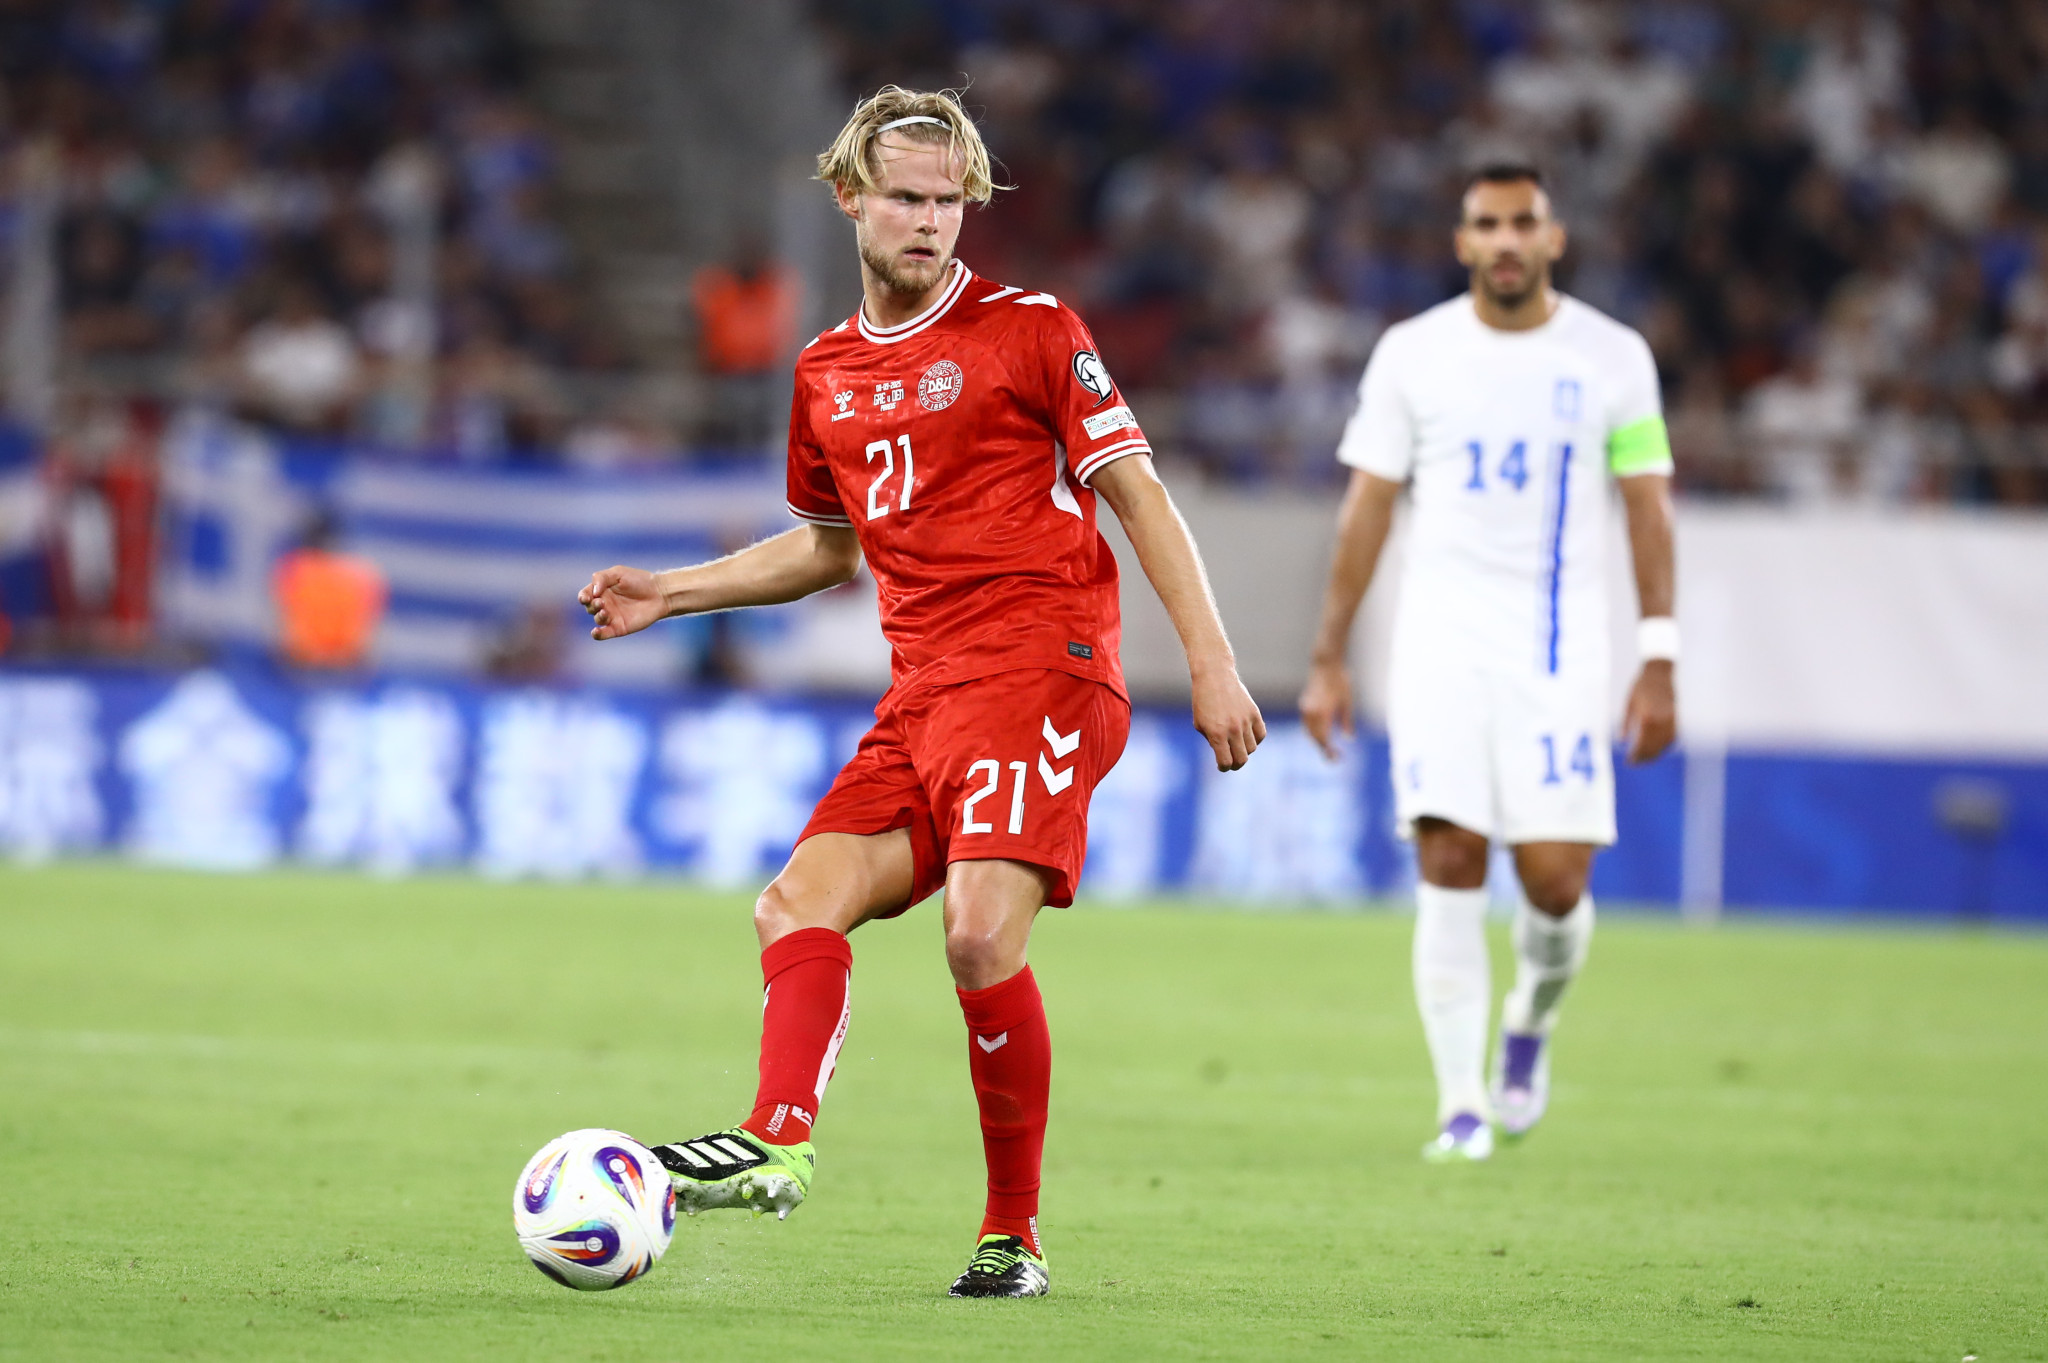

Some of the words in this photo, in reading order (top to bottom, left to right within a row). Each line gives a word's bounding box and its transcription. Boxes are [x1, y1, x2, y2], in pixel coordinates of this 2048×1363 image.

[927, 376, 953, 394] DBU
[930, 400, 949, 410] 1889
[865, 433, 914, 522] 21
[1464, 438, 1530, 491] 14
[1539, 732, 1597, 785] 14
[961, 758, 1028, 836] 21
